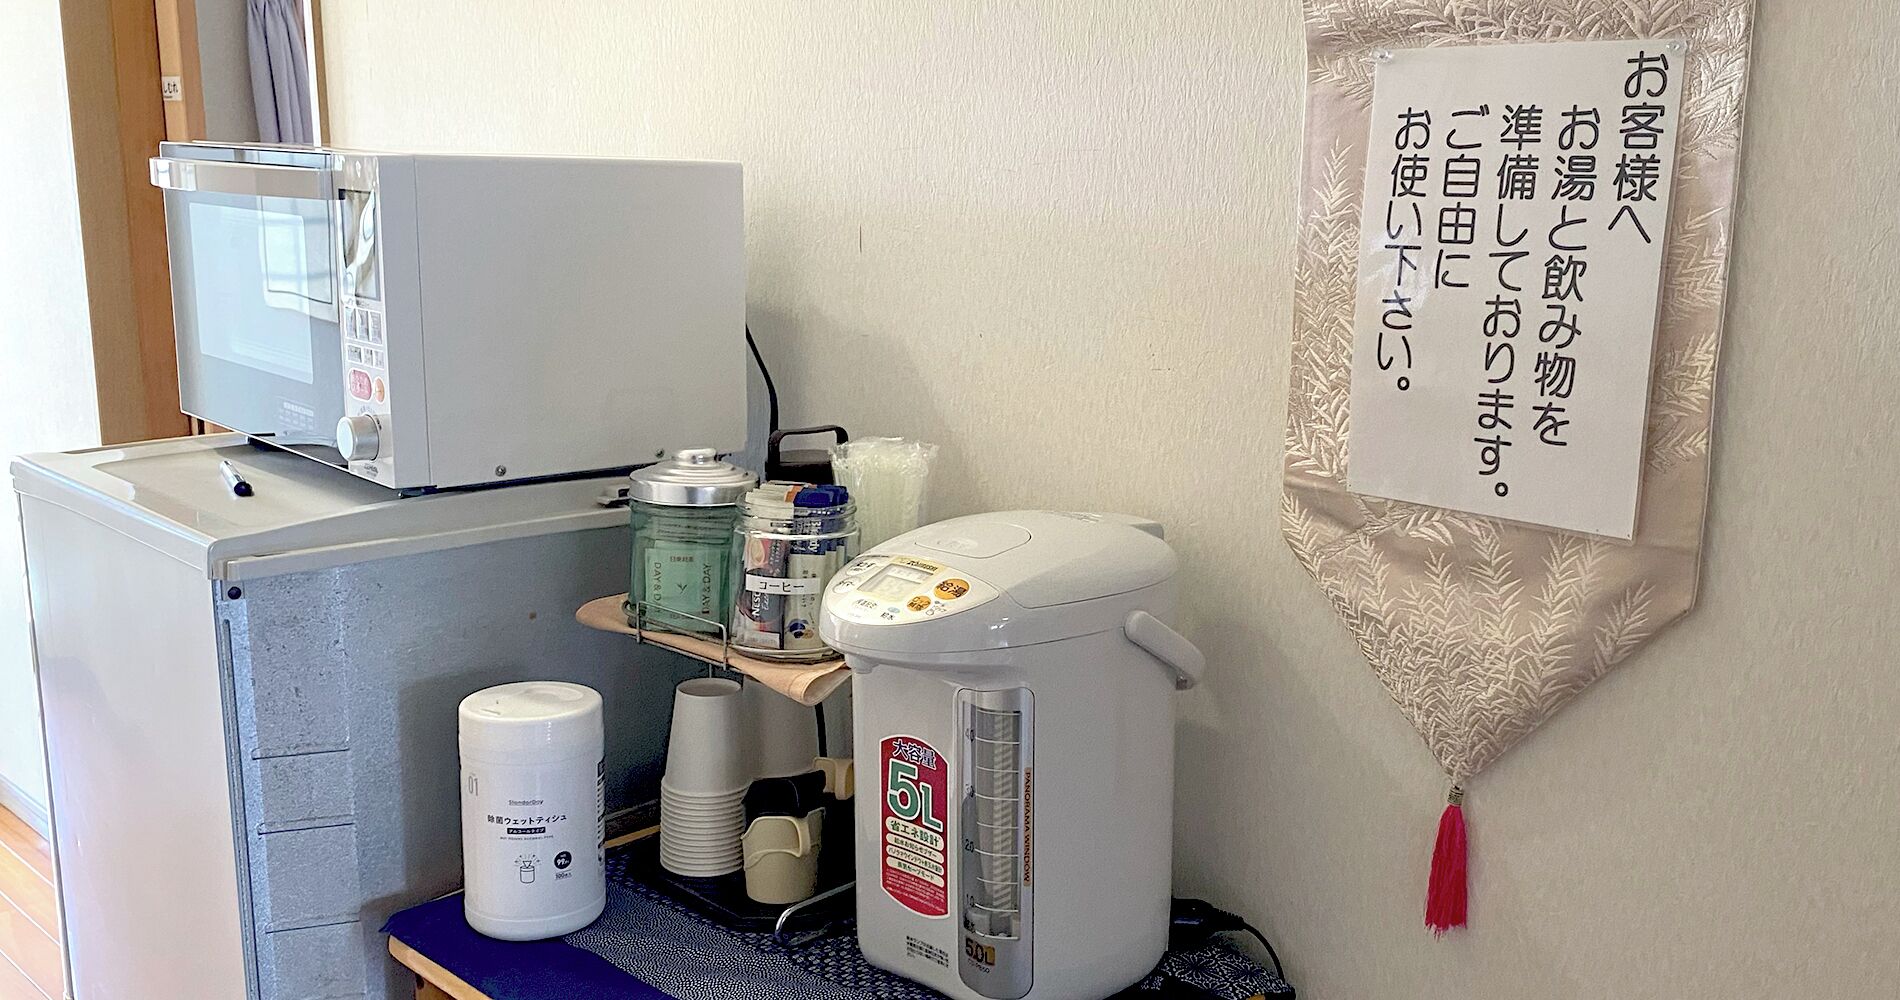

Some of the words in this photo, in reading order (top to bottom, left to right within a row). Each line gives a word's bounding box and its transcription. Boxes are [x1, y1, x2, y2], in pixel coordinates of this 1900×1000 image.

[1607, 50, 1670, 244] お客様へ
[1434, 104, 1490, 290] ご自由に
[1376, 107, 1431, 392] お使い下さい。
[1532, 105, 1601, 447] お湯と飲み物を
[1474, 104, 1543, 498] 準備しております。
[759, 580, 805, 593] コーヒー
[468, 775, 479, 797] 01
[892, 739, 937, 770] 大容量
[887, 758, 943, 832] 5L
[890, 820, 940, 847] 省エネ設計
[1023, 834, 1031, 882] WINDOW
